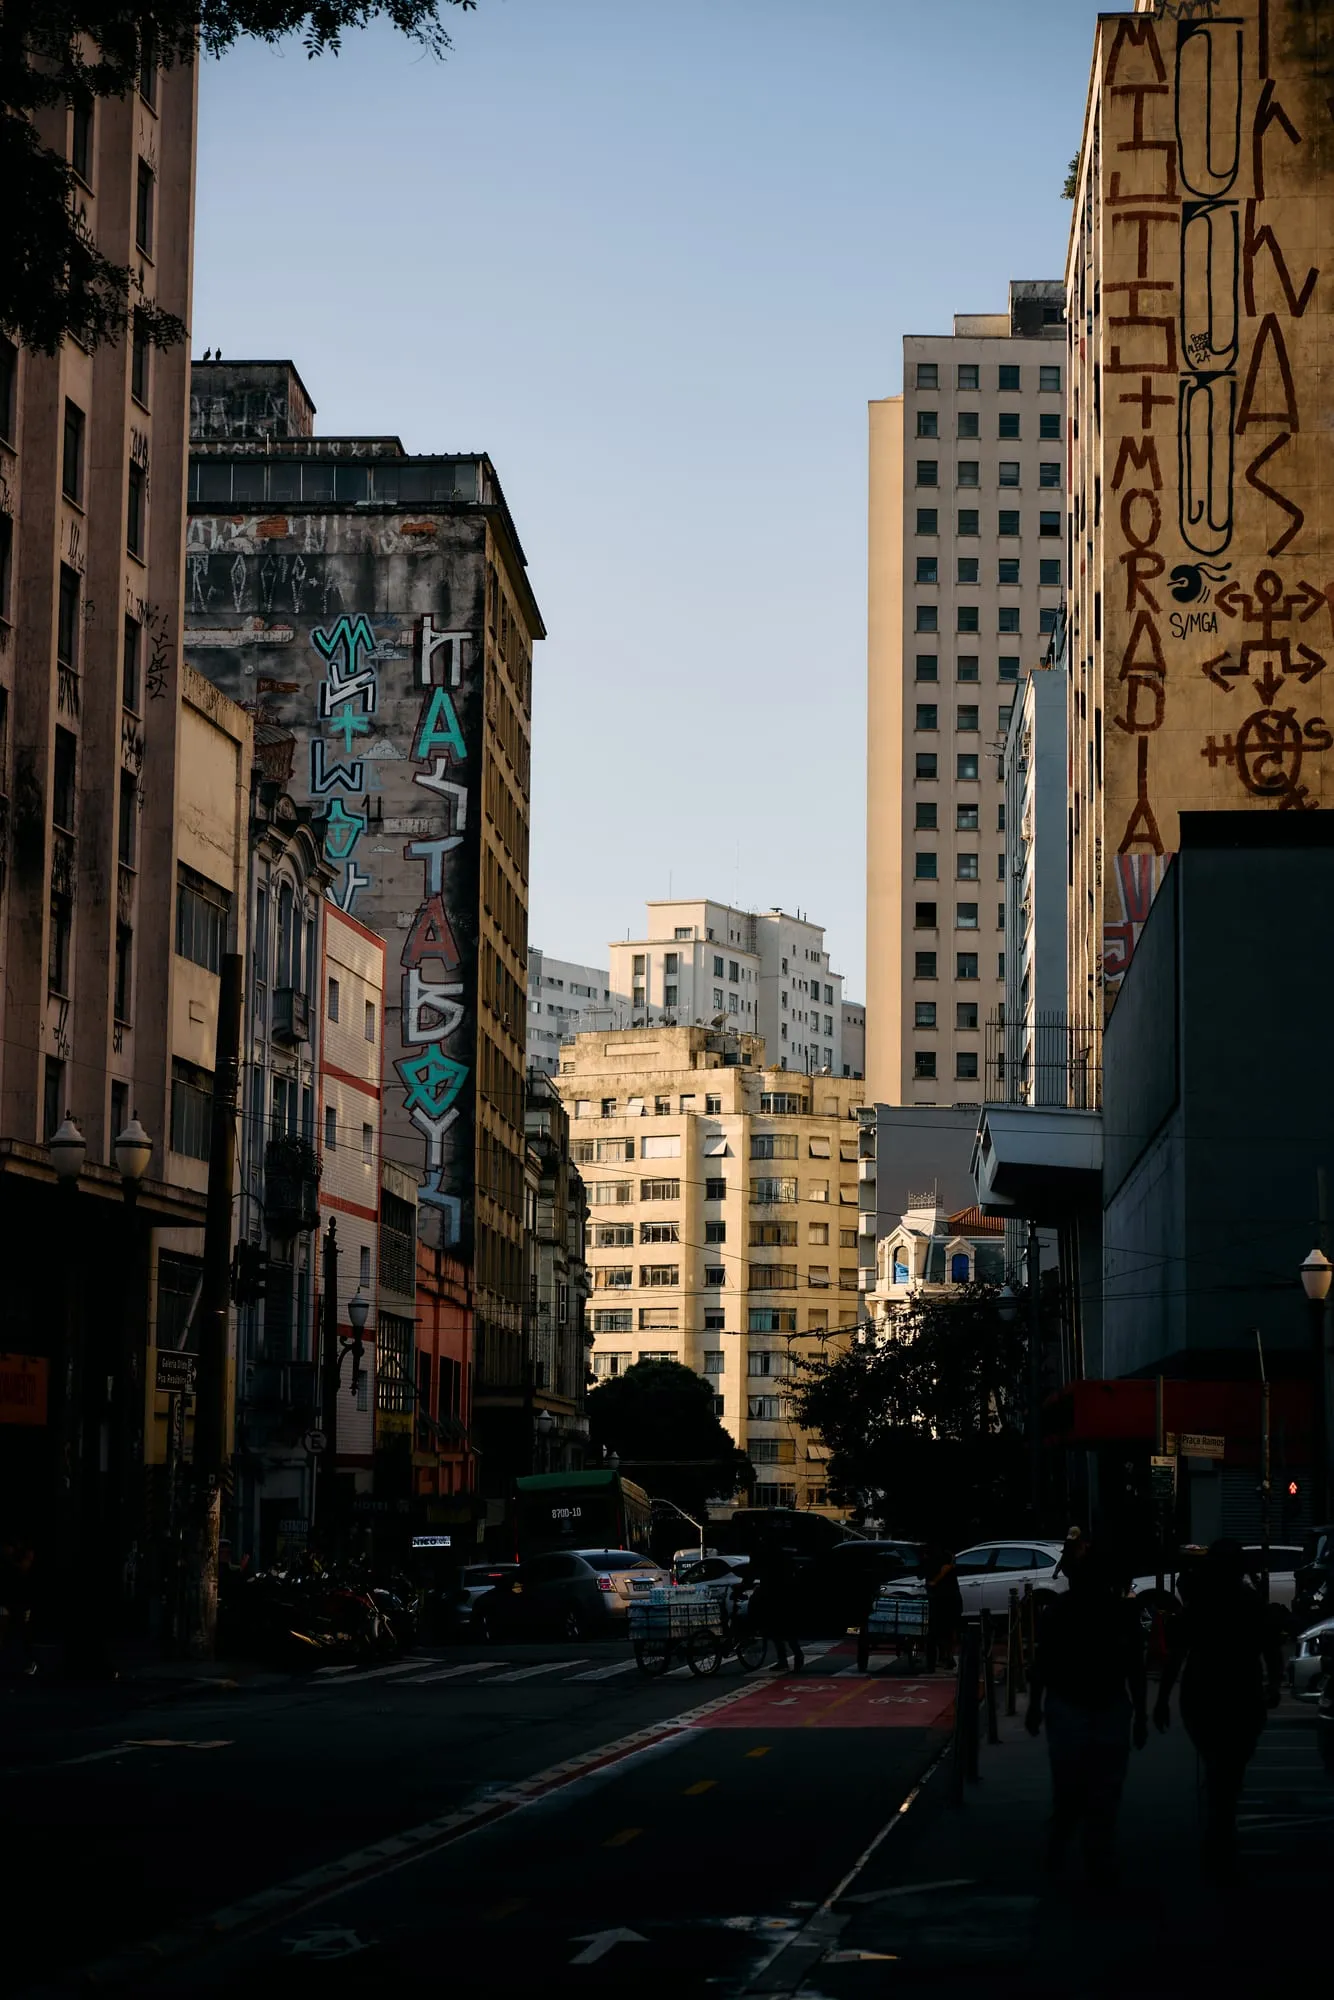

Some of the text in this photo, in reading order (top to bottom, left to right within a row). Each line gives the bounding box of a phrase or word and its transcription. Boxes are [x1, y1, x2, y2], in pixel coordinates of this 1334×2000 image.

[1182, 1435, 1201, 1447] Praça
[1202, 1436, 1225, 1448] Ramos
[551, 1507, 582, 1519] 8700-10
